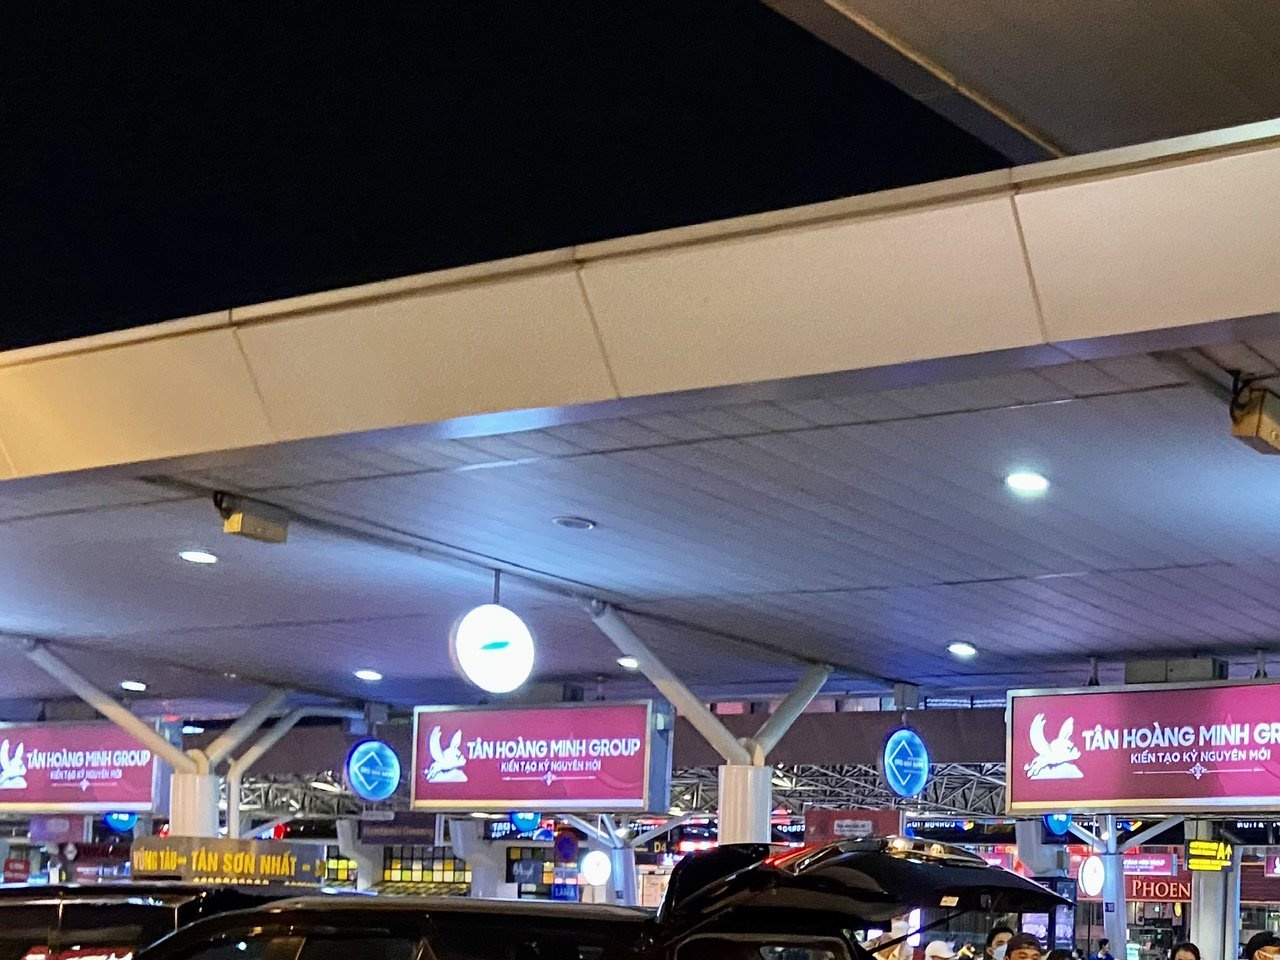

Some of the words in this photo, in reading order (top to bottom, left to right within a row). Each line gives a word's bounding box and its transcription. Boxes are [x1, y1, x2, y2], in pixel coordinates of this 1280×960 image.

[1082, 724, 1119, 750] TÂN
[1123, 722, 1195, 749] HOÀNG
[1199, 723, 1250, 746] MINH
[26, 749, 47, 769] TÂN
[47, 748, 84, 769] HOÀNG
[85, 750, 111, 767] MINH
[113, 750, 151, 767] GROUP
[467, 737, 494, 760] TÂN
[496, 736, 548, 759] HOÀNG
[550, 738, 586, 758] MINH
[588, 738, 641, 757] GROUP
[1130, 750, 1155, 764] KIẾN
[1157, 752, 1181, 765] TẠO
[1200, 749, 1247, 763] NGUYÊN
[1249, 749, 1271, 761] MỚI
[192, 849, 219, 872] TÂN
[223, 852, 255, 875] SƠN
[260, 850, 297, 876] NHẤT
[1132, 880, 1191, 898] PHOEN
